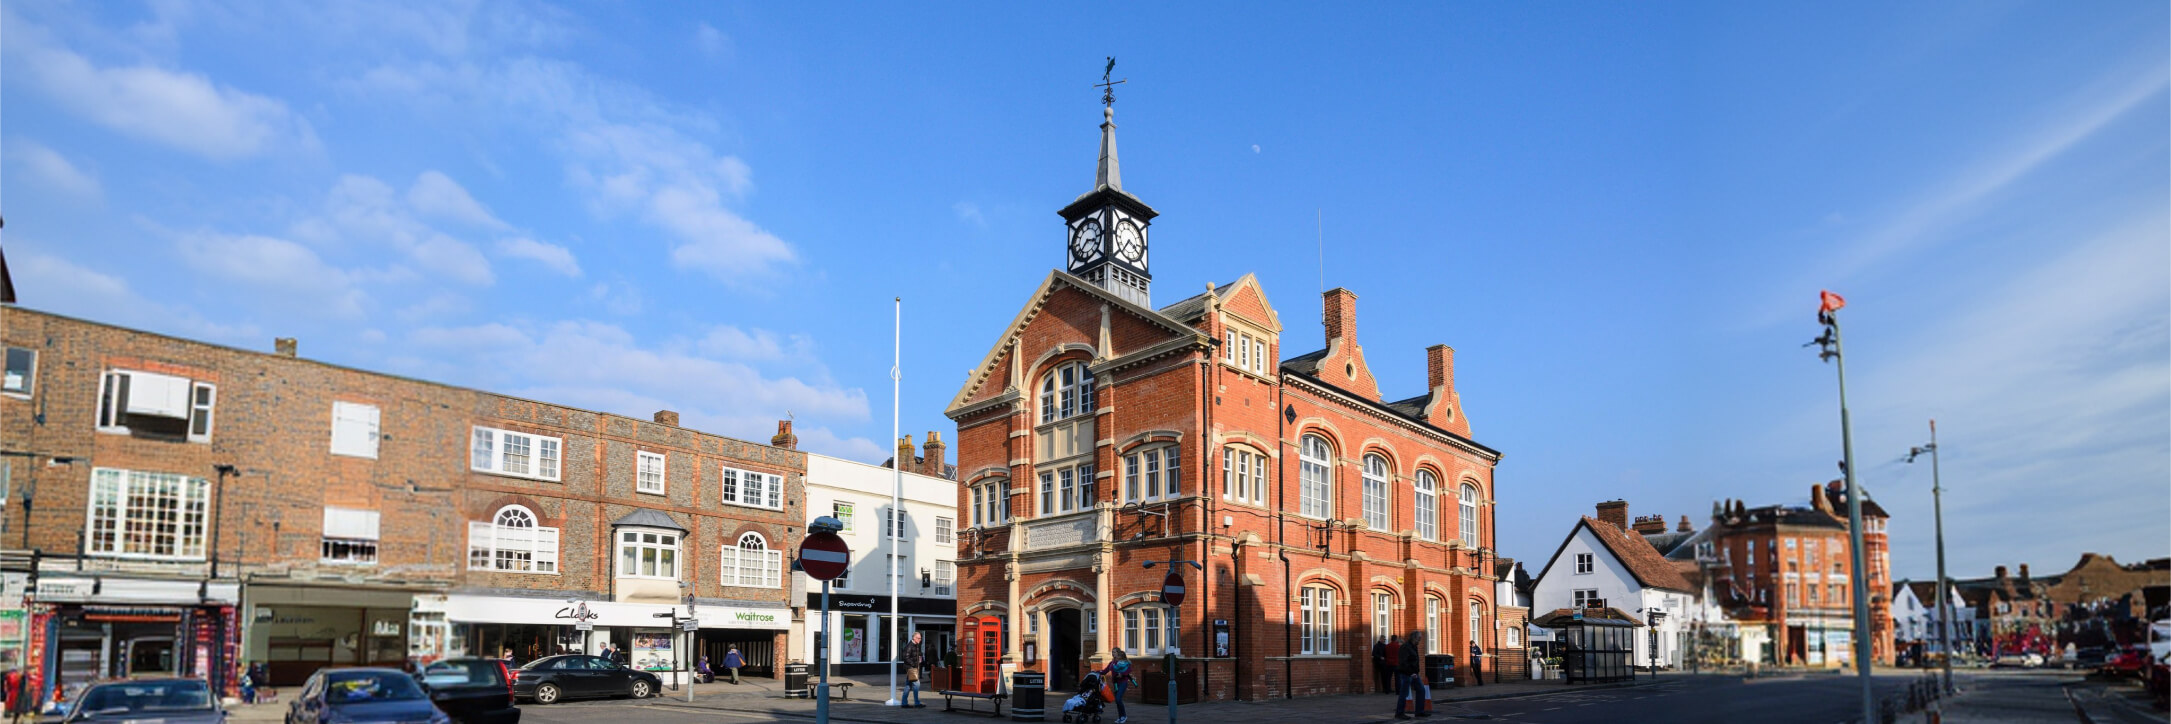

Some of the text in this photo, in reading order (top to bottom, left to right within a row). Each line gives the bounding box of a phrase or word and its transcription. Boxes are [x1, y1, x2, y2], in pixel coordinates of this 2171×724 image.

[839, 600, 872, 609] Superdrug
[555, 607, 599, 620] Claks
[735, 612, 774, 622] Waitrose
